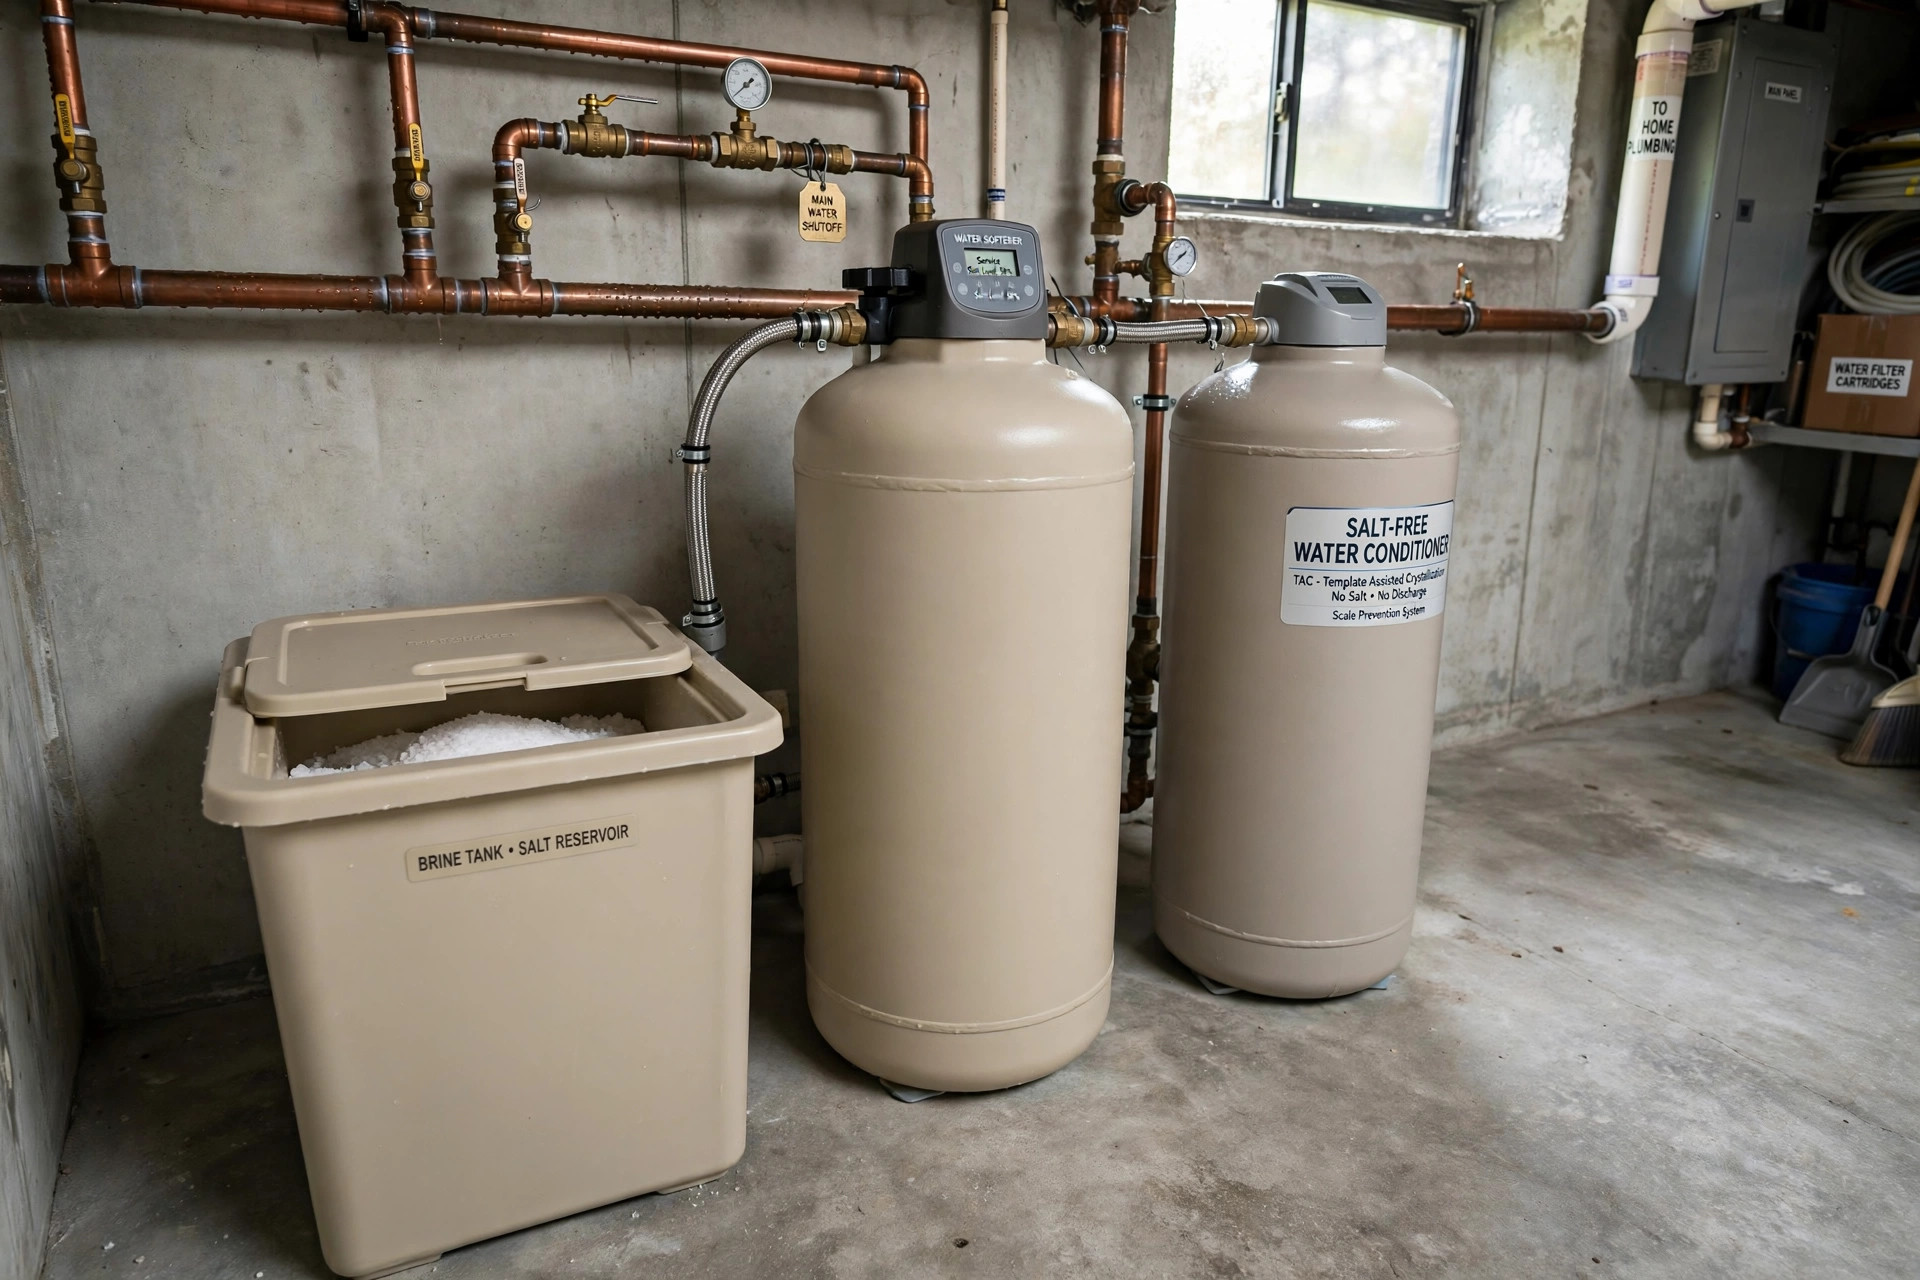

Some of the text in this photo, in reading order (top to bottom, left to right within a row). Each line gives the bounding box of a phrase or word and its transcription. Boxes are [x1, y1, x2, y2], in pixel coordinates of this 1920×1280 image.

[1652, 100, 1668, 116] TO
[1641, 119, 1675, 135] HOME
[811, 195, 833, 206] MAIN
[807, 207, 838, 219] WATER
[802, 221, 843, 233] SHUTOFF
[953, 233, 982, 244] WATER
[1834, 362, 1906, 377] WATER FILTER
[1835, 376, 1901, 391] CARTRIDGES
[1345, 514, 1429, 538] SALT-FREE
[1294, 534, 1449, 564] WATER CONDITIONER
[1293, 574, 1313, 586] TAC
[1323, 575, 1367, 590] Template
[1369, 573, 1404, 587] Assisted
[1331, 591, 1346, 602] No
[1348, 590, 1368, 602] Salt
[1377, 589, 1390, 601] No
[1332, 609, 1356, 621] Scale
[1358, 608, 1400, 620] Prevention
[418, 824, 630, 872] BRINE TANK SALT RESERVOIR
